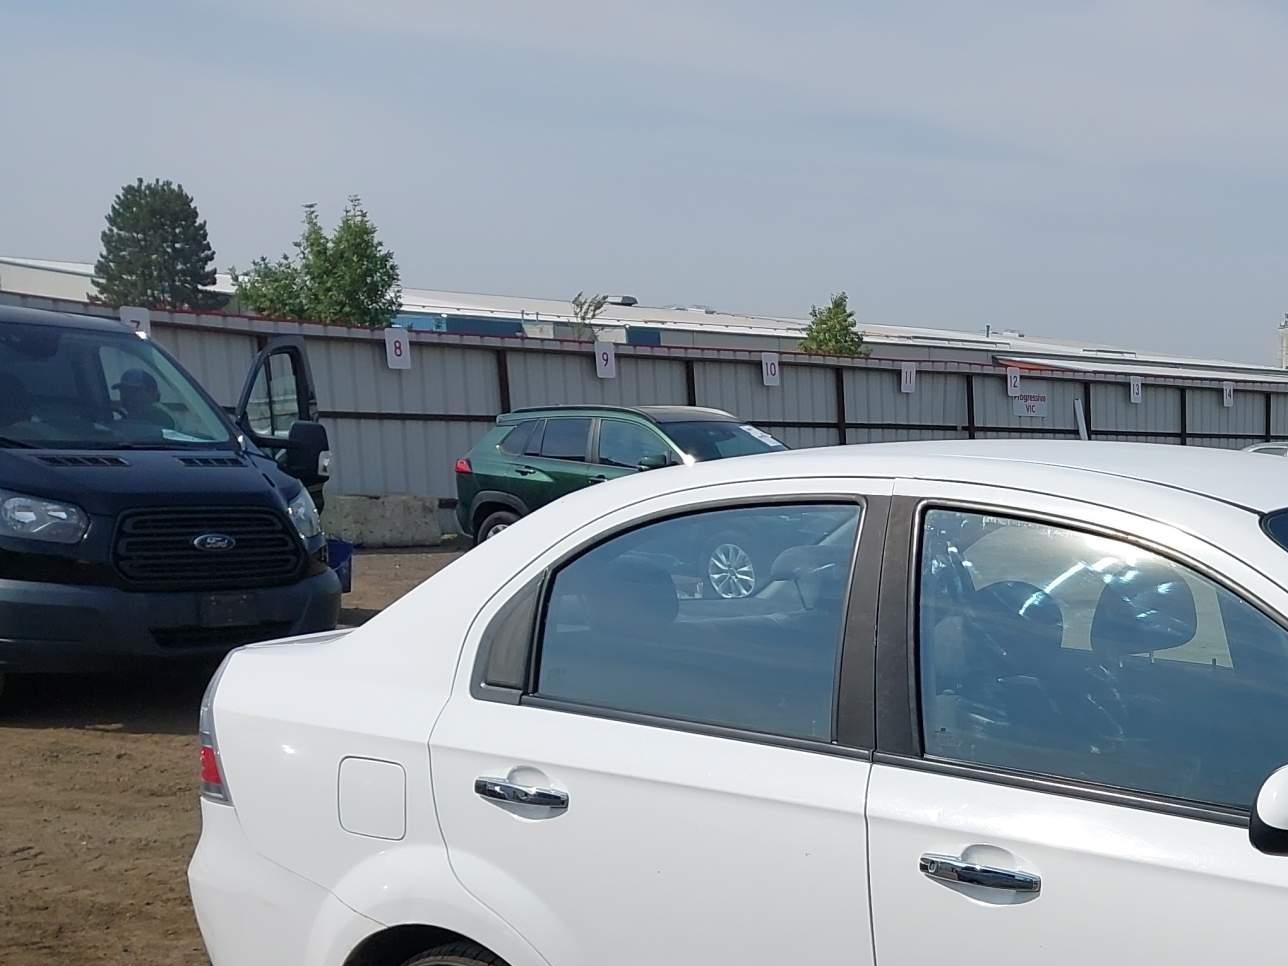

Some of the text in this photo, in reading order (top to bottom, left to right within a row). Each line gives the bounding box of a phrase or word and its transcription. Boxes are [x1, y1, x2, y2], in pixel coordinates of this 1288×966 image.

[394, 340, 402, 357] 8
[602, 351, 609, 367] 9
[766, 361, 776, 377] 10
[905, 371, 912, 384] 11
[1010, 375, 1018, 388] 12
[1133, 383, 1140, 396] 13
[1225, 388, 1232, 400] 14
